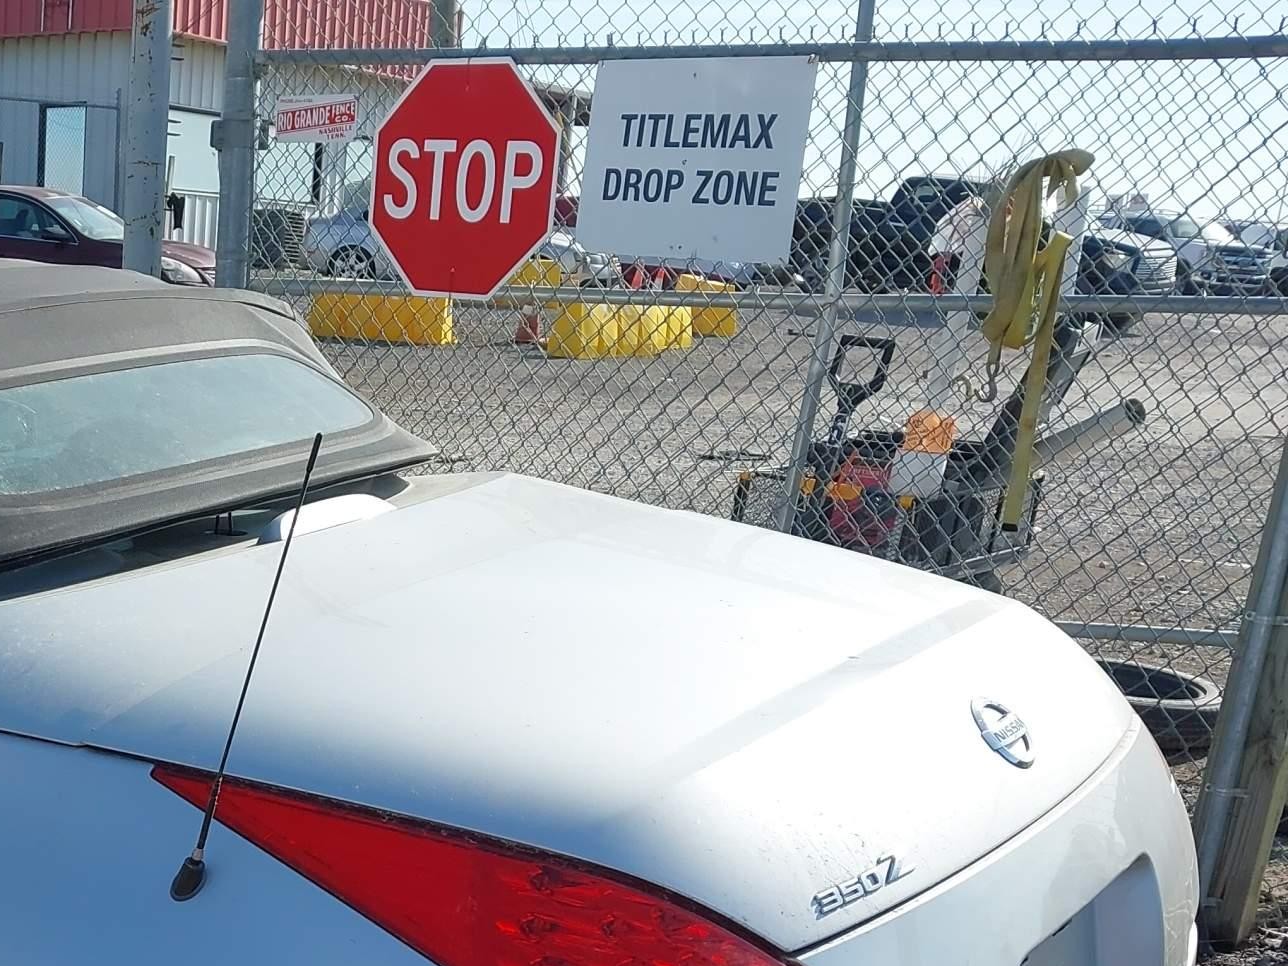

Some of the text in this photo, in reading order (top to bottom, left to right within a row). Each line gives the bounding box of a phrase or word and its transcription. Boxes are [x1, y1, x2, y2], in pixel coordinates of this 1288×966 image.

[278, 102, 355, 132] RIO GRANDE FENCE
[334, 114, 352, 123] CO.
[620, 112, 778, 150] TITLEMAX
[382, 138, 544, 225] STOP
[601, 167, 781, 207] DROP ZONE
[809, 854, 917, 920] 350Z
